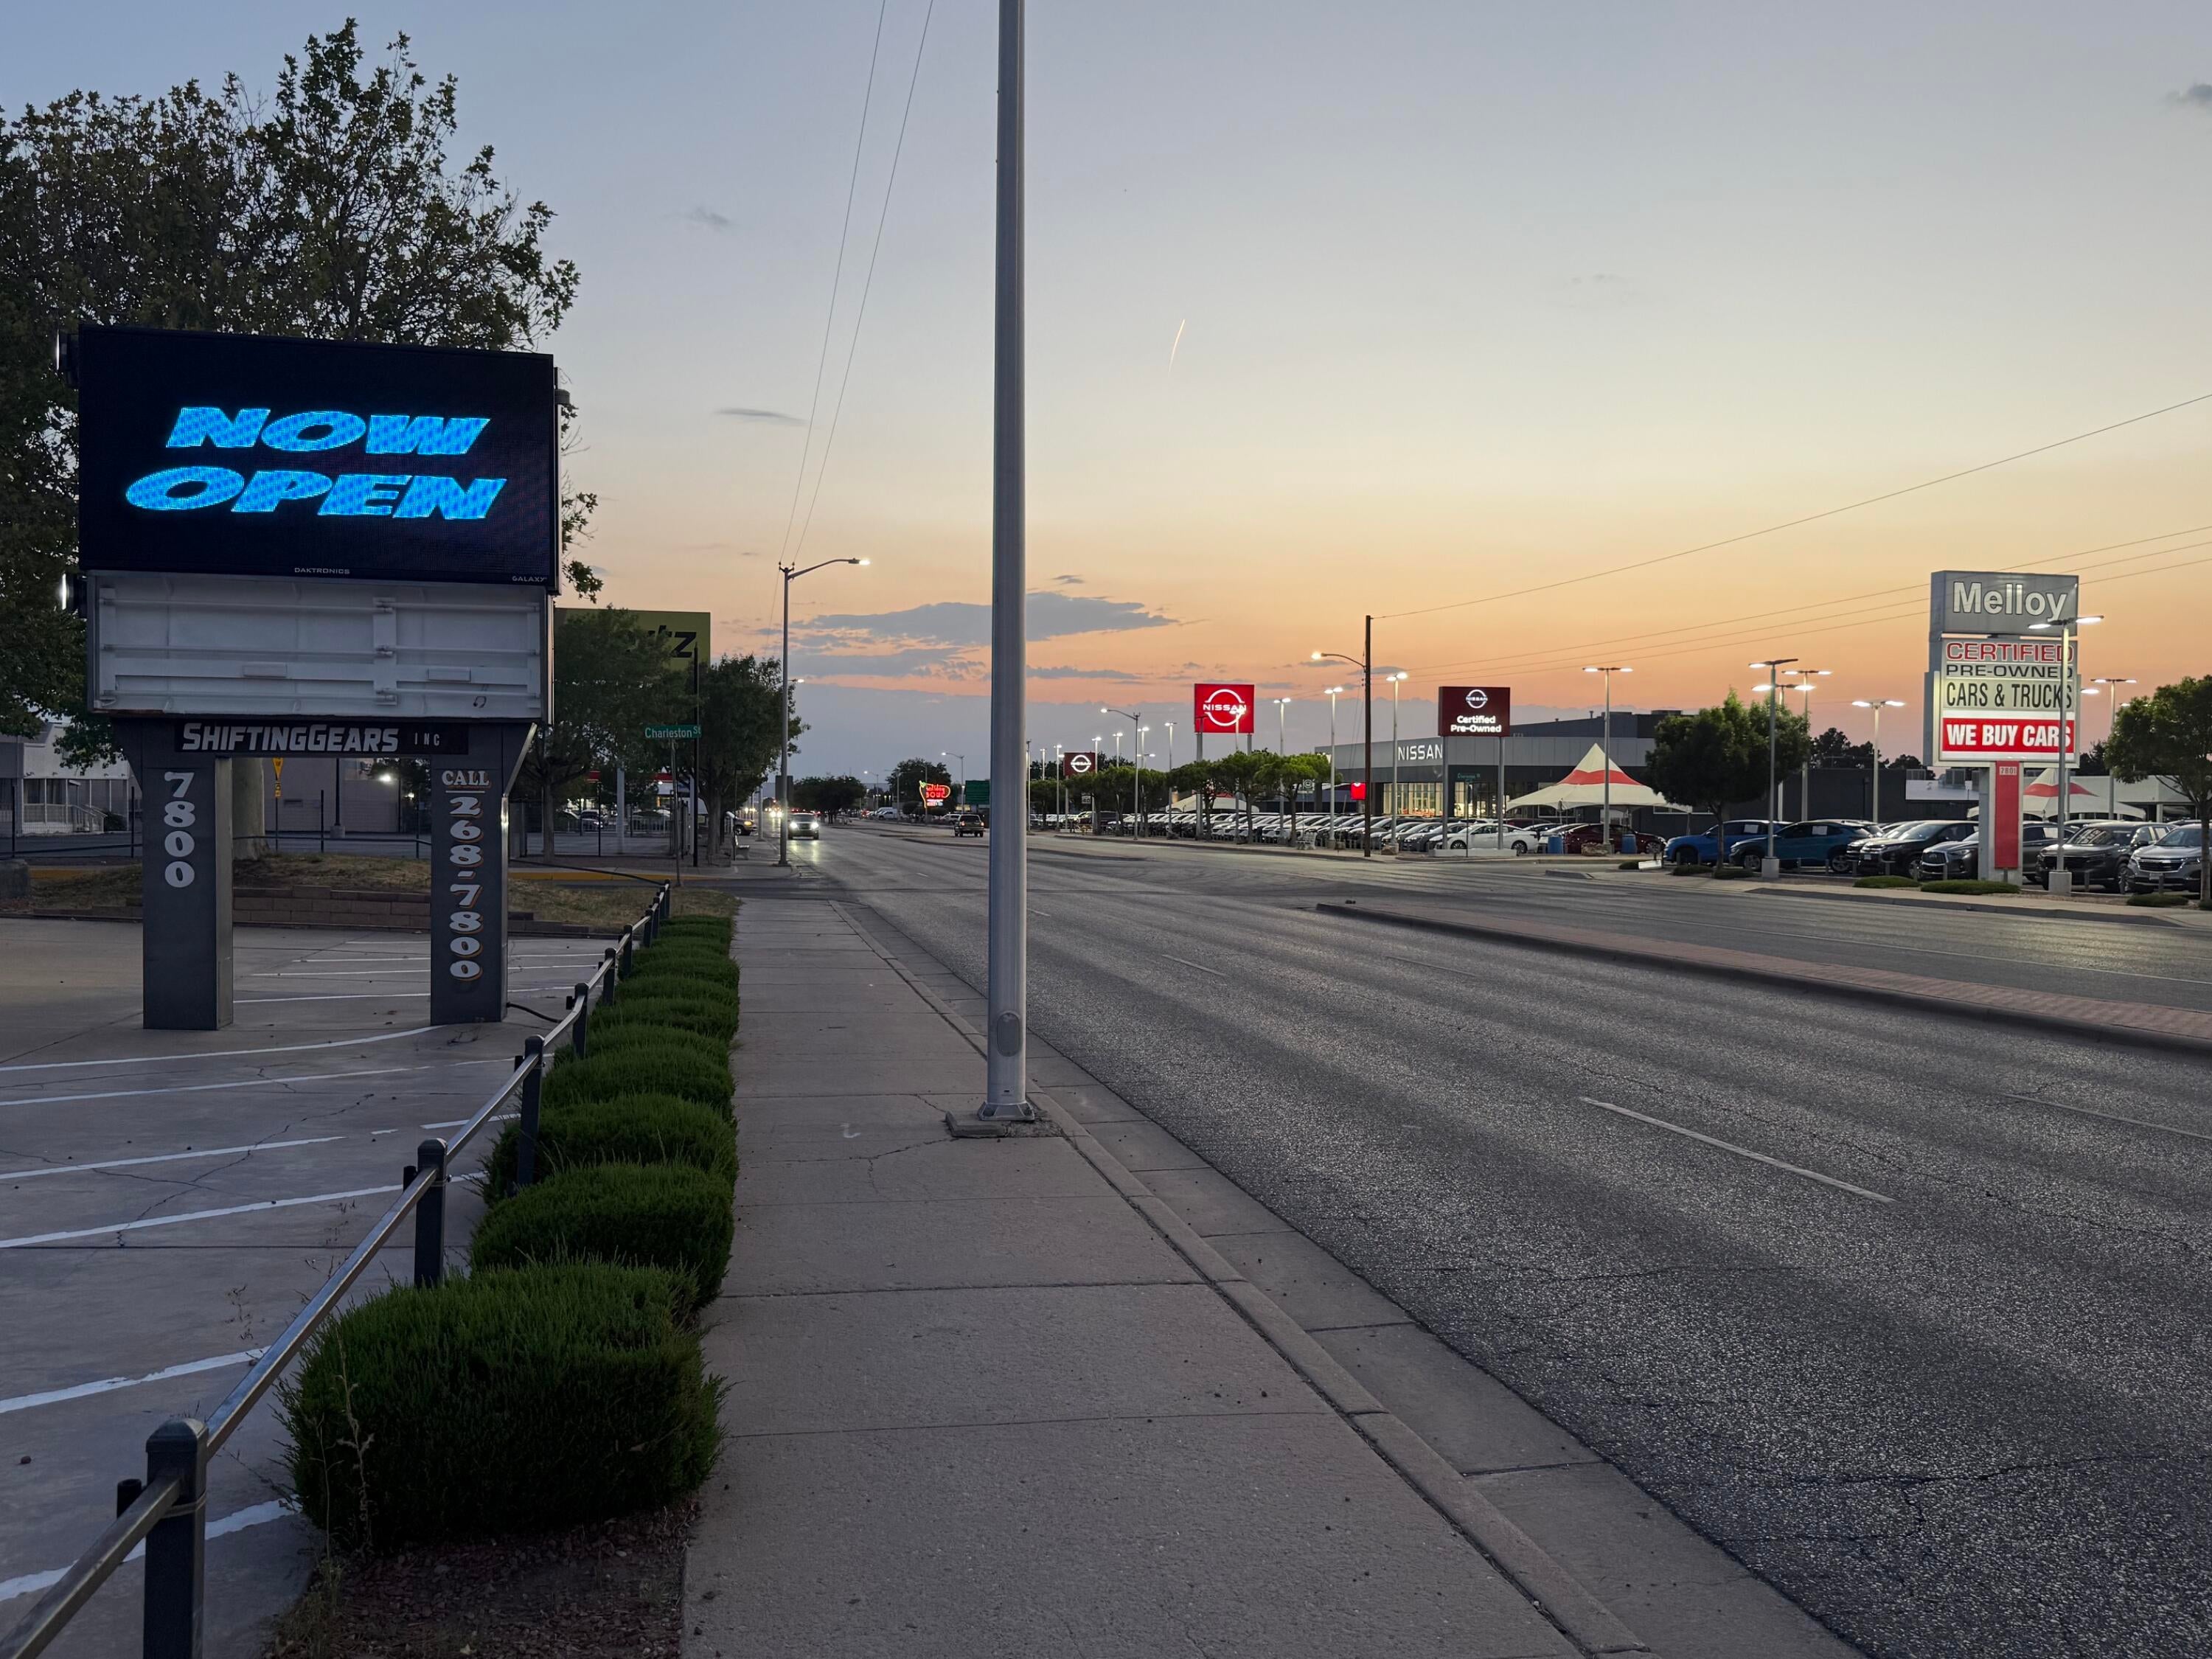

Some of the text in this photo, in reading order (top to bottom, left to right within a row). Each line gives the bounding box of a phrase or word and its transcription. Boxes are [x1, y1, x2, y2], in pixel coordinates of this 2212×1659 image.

[166, 406, 490, 456] NOW
[125, 465, 507, 521] OPEN
[1953, 581, 2067, 623] Melloy
[1946, 641, 2074, 663] CERTIFIED
[1947, 681, 2073, 709] CARS & TRUCKS
[1203, 703, 1247, 712] NISSAN
[1450, 724, 1502, 733] Pre-Owned
[1456, 714, 1496, 724] Certified
[414, 733, 441, 747] INC
[644, 726, 701, 738] Charleston St
[1947, 724, 2071, 748] WE BUY CARS
[1398, 743, 1443, 761] NISSAN
[442, 770, 491, 787] CALL
[164, 771, 195, 888] 7800
[449, 796, 483, 982] 268-7800
